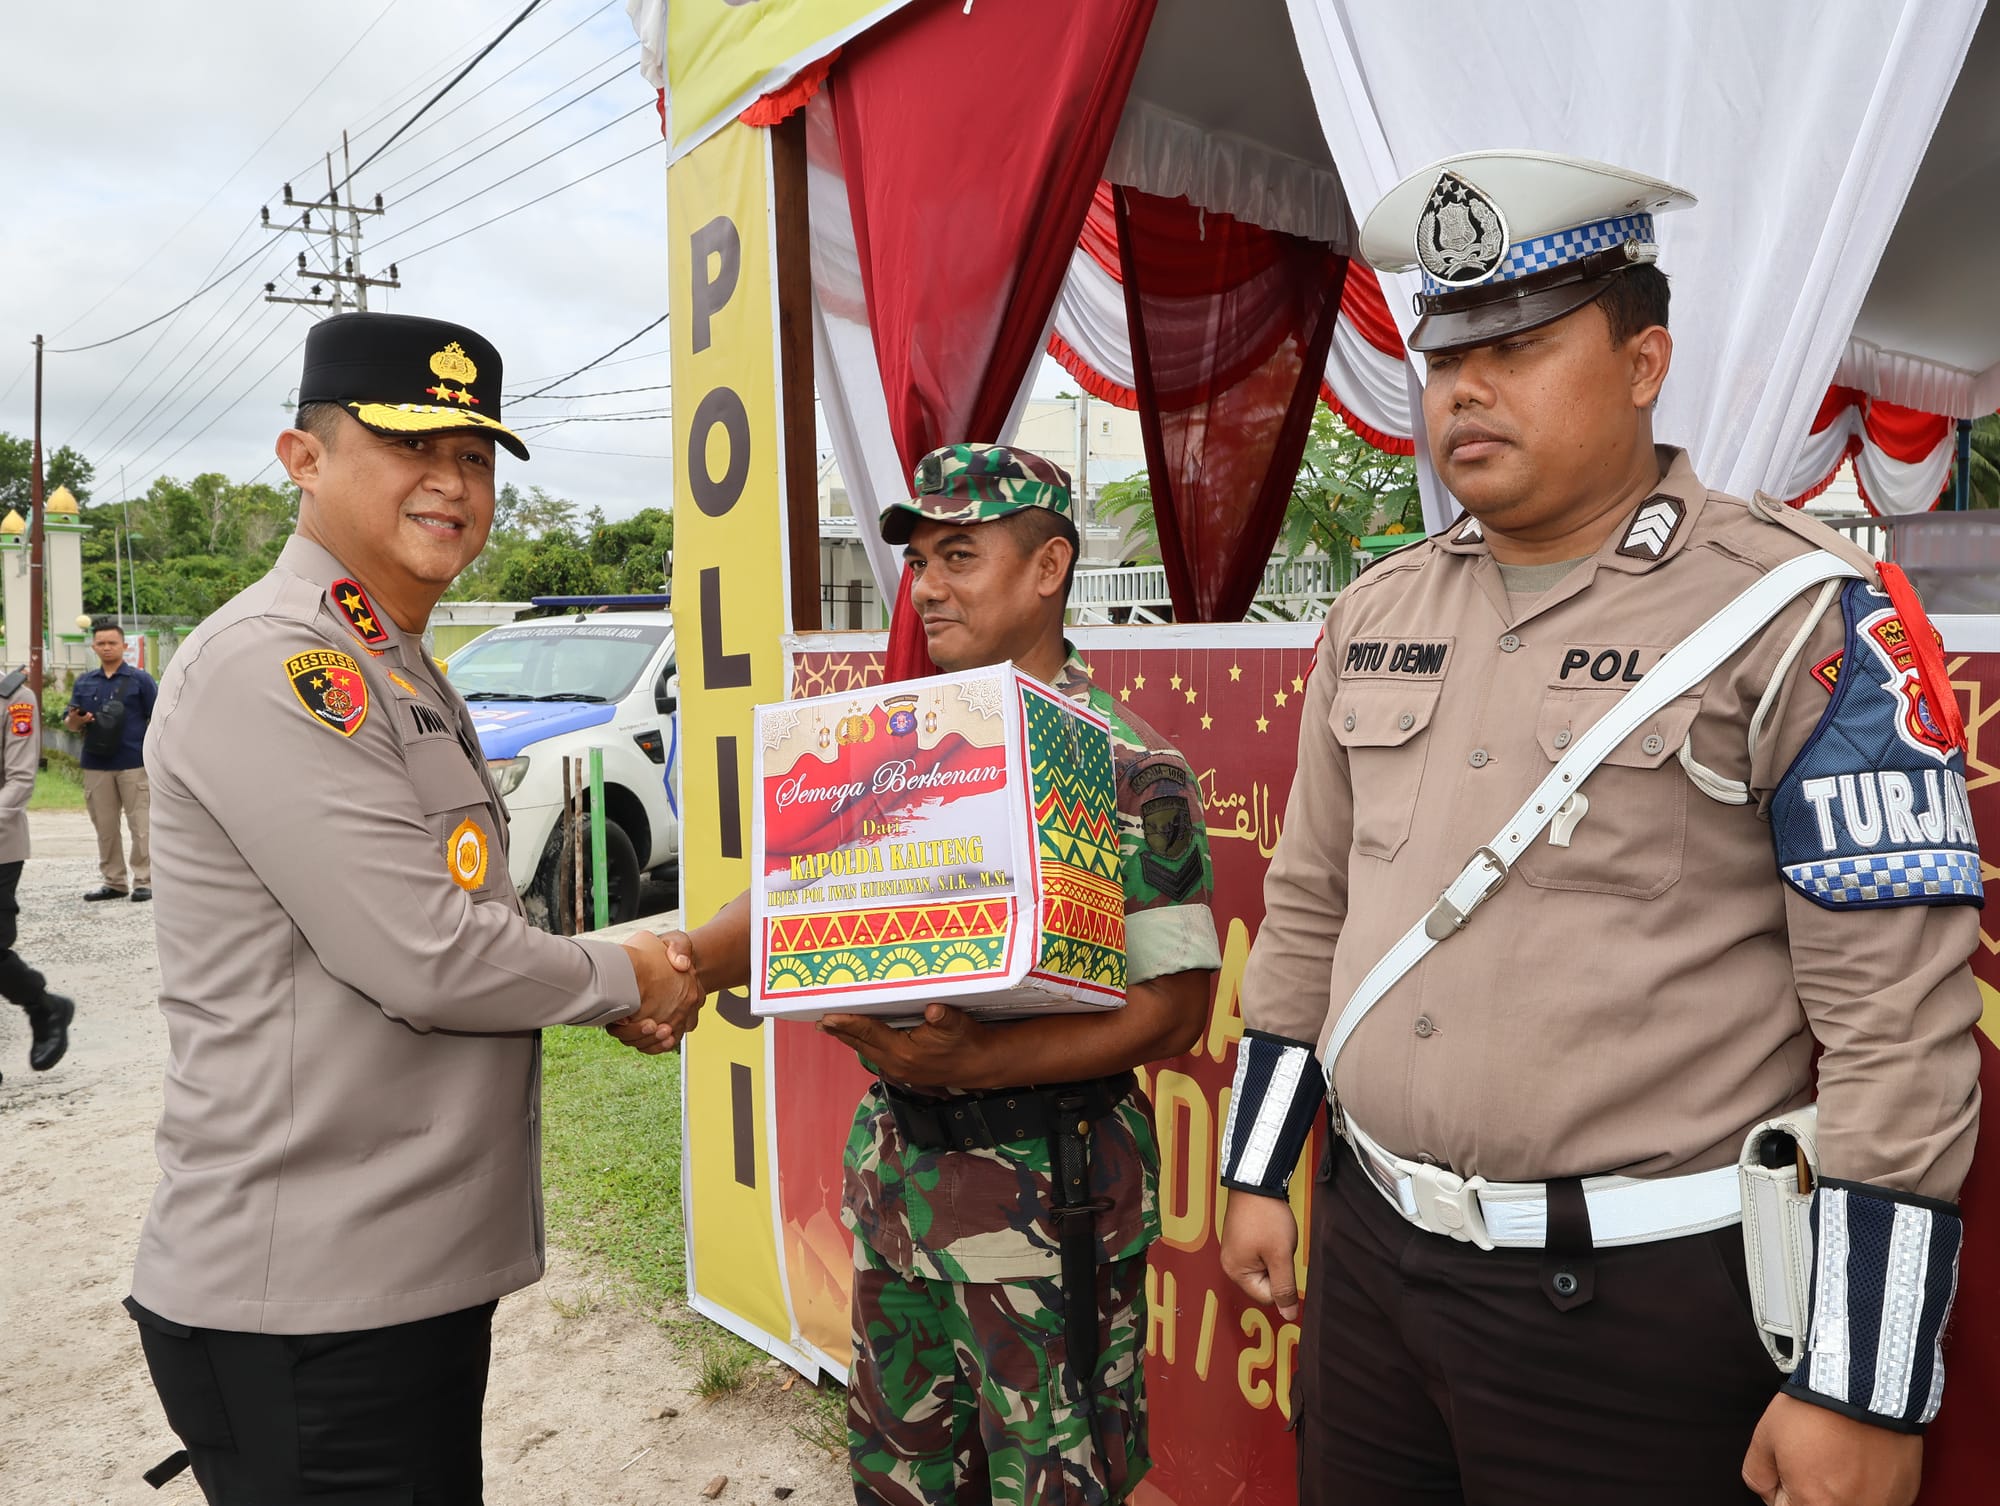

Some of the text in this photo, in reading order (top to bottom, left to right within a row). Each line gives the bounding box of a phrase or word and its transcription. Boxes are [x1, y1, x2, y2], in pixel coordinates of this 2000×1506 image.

[615, 627, 642, 639] RAYA
[1878, 620, 1905, 640] POL
[290, 653, 356, 676] RESERSE
[1345, 642, 1447, 674] PUTU DENNI
[1560, 649, 1664, 682] POL
[776, 759, 1003, 814] Semoga Berkenan
[1802, 769, 1978, 852] TURJA
[863, 817, 900, 837] Dari
[790, 836, 984, 881] KAPOLDA KALTENG
[768, 889, 798, 908] IRJEN
[802, 887, 825, 904] POL
[828, 882, 858, 902] IWAN
[860, 876, 935, 898] KURNIAWAN,
